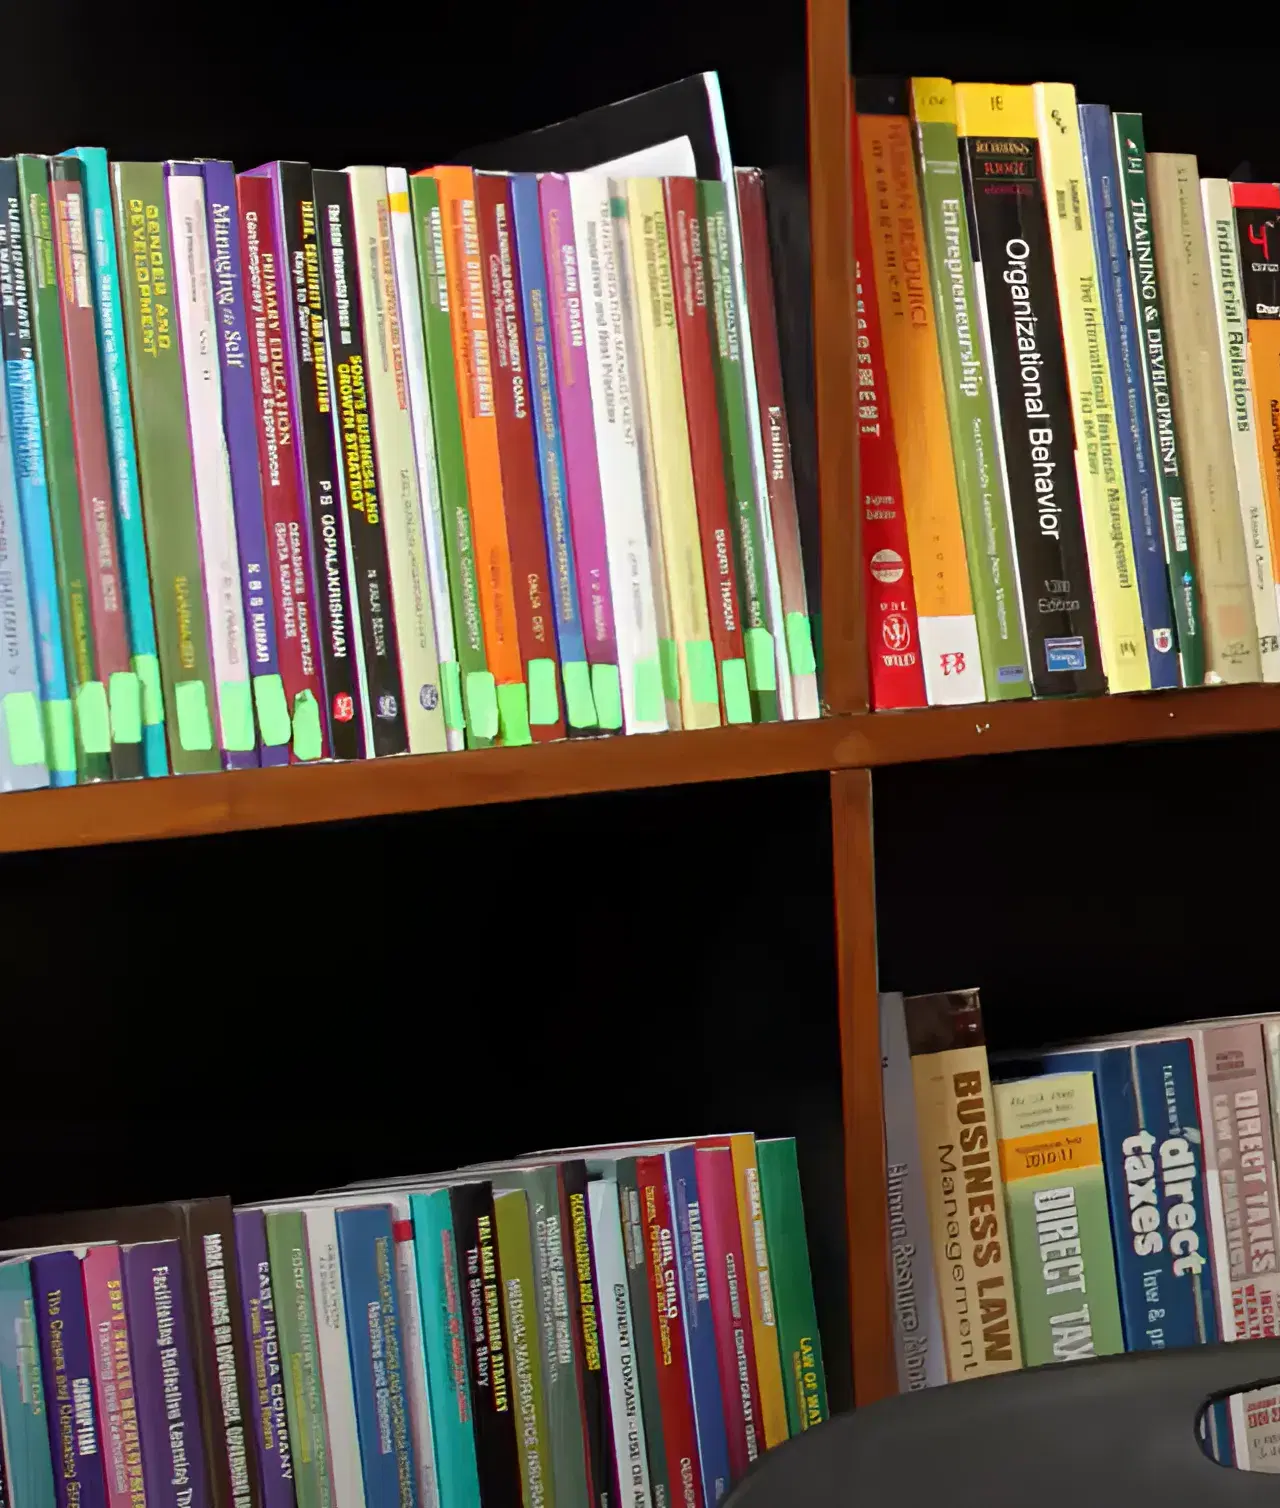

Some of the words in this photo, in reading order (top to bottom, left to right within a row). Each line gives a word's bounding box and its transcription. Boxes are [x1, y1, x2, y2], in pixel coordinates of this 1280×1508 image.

[261, 253, 281, 330] PRIMARY
[942, 199, 982, 397] Entrepreneurship
[1131, 197, 1157, 300] TRAINING
[155, 304, 171, 350] AND
[1144, 306, 1158, 322] &
[1216, 219, 1242, 323] Industrial
[1233, 331, 1251, 432] Relations
[270, 338, 291, 445] EDUCATION
[1003, 238, 1050, 420] Organizational
[1028, 427, 1063, 540] Behavior
[1146, 328, 1179, 477] DEVELOPMENT
[952, 1070, 1003, 1268] BUSINESS
[1121, 1129, 1164, 1256] taxes
[1159, 1137, 1207, 1278] direct
[937, 1144, 979, 1372] Management
[1034, 1186, 1086, 1295] DIRECT
[264, 1320, 280, 1376] INDIA
[977, 1276, 1013, 1362] LAW
[271, 1383, 293, 1480] COMPANY
